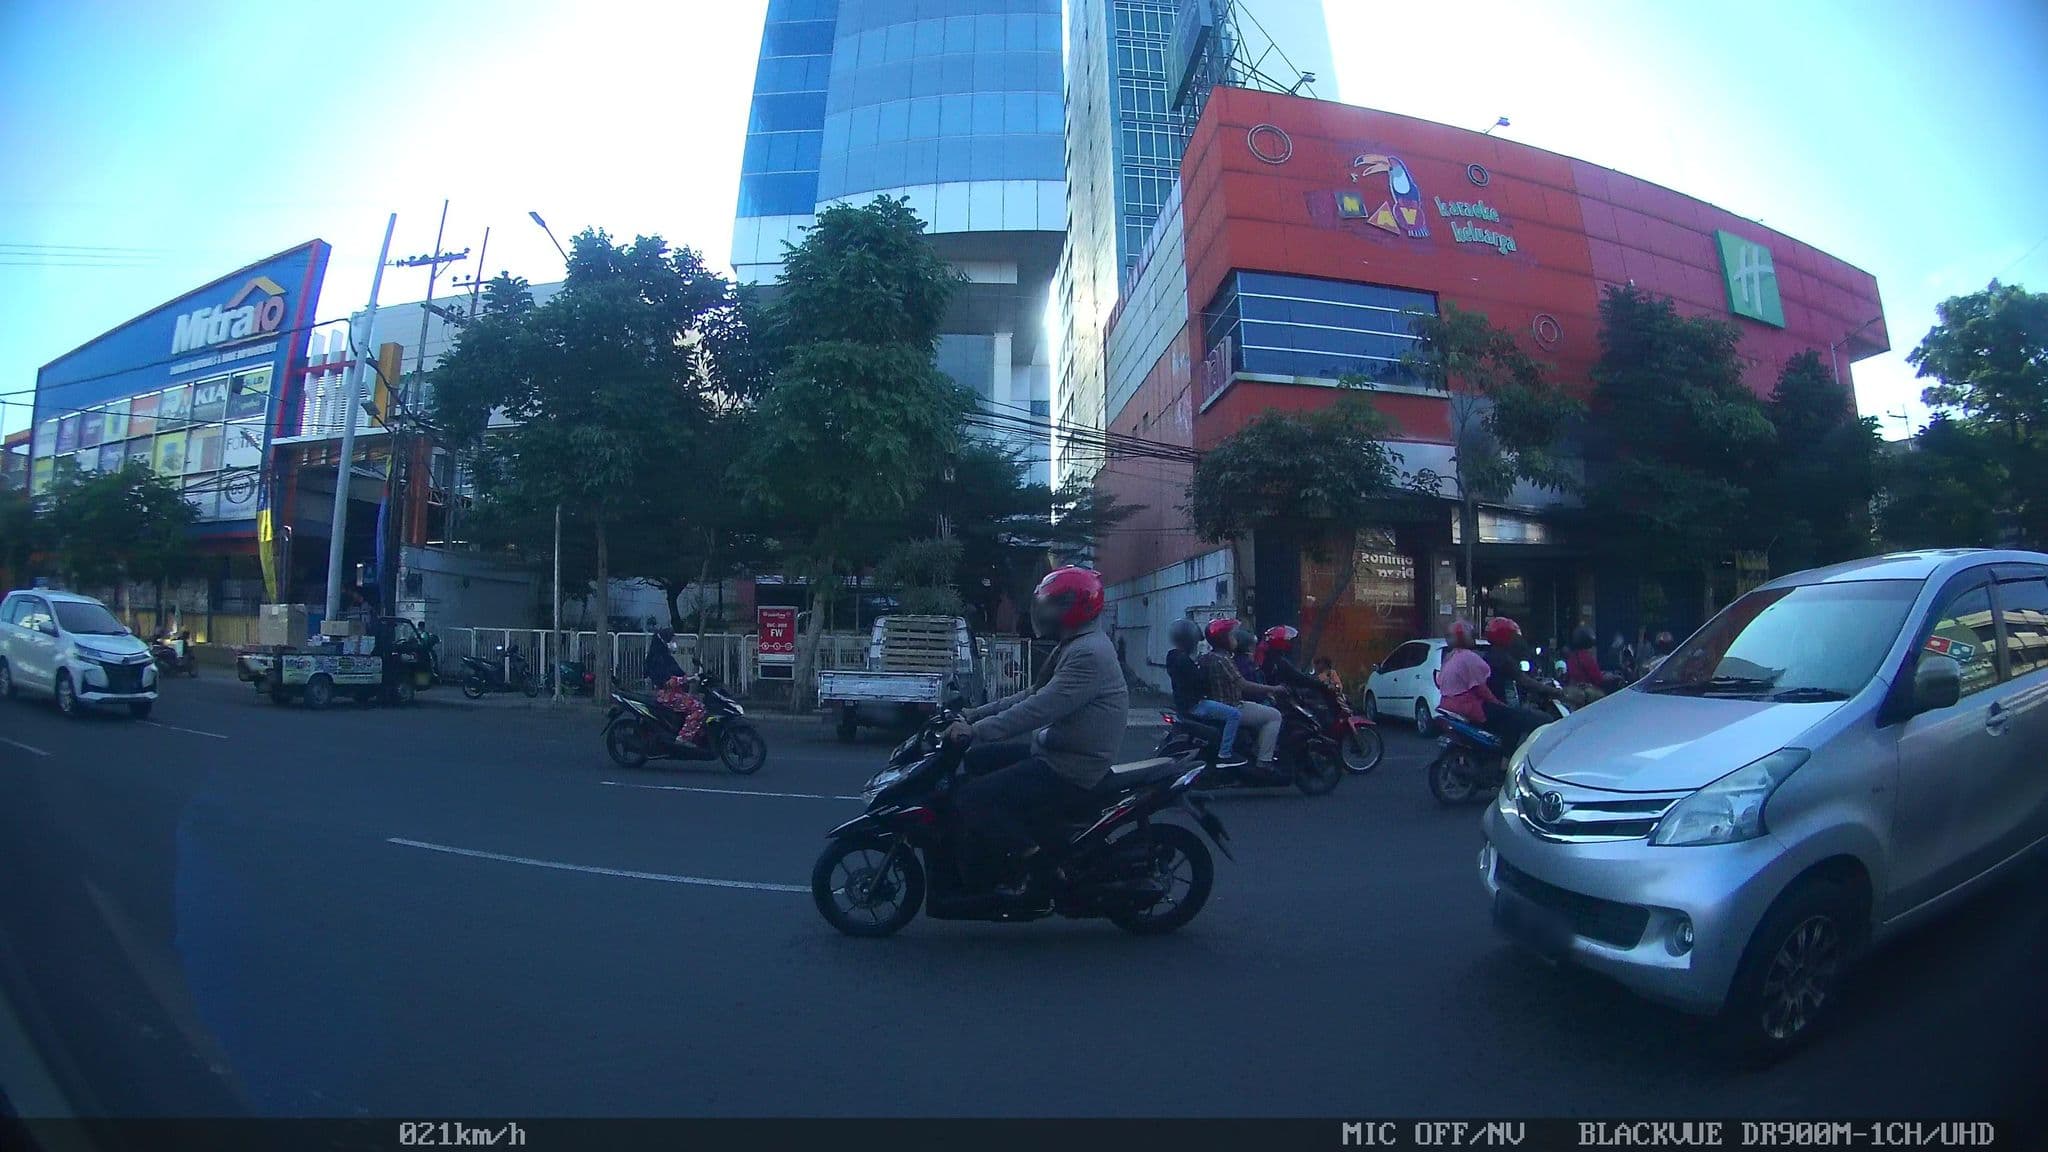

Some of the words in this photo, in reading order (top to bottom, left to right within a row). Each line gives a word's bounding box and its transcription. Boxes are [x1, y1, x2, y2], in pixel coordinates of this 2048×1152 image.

[1434, 196, 1500, 223] karaoke
[1451, 221, 1517, 255] keluarga
[171, 295, 284, 355] Mitra10
[194, 383, 227, 406] KIA
